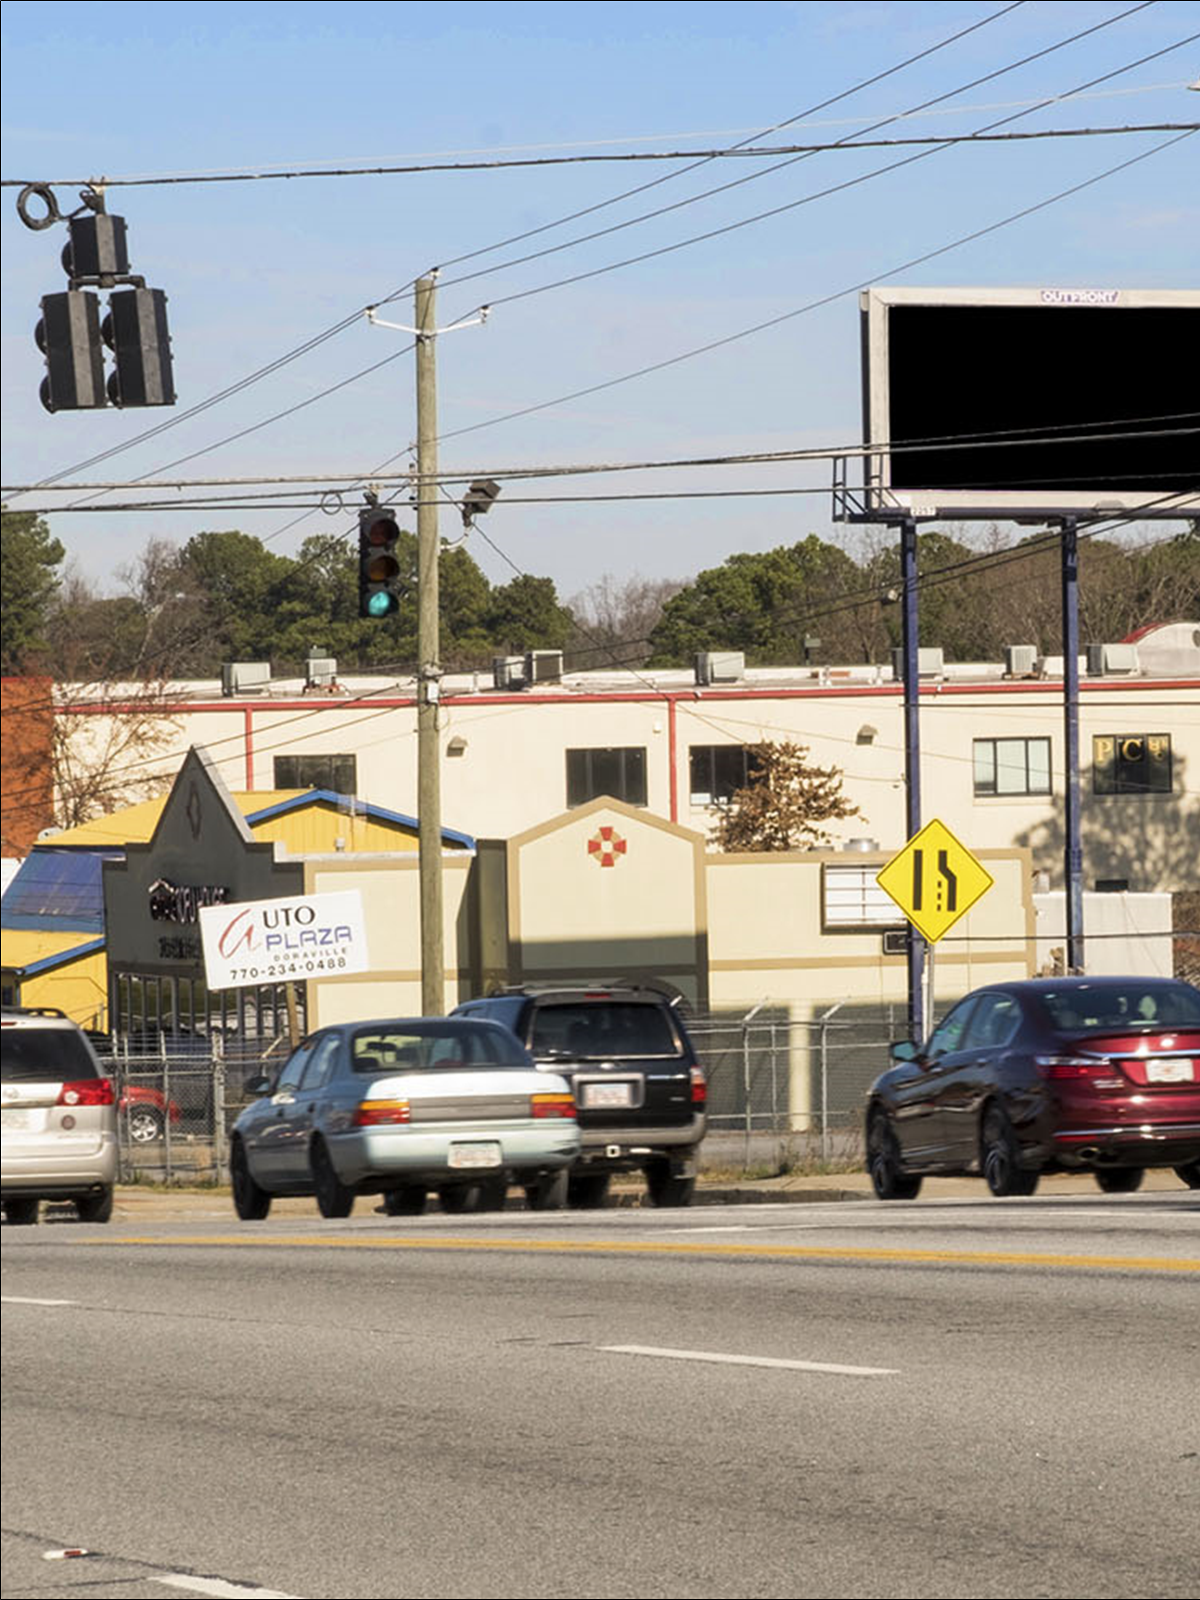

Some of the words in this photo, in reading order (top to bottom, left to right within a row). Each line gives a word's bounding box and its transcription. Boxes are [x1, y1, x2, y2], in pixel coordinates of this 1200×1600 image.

[1041, 289, 1118, 303] OUTFRONT
[265, 925, 353, 952] PLAZA
[273, 946, 347, 962] DORAVILLE
[229, 957, 347, 980] 770-234-0488
